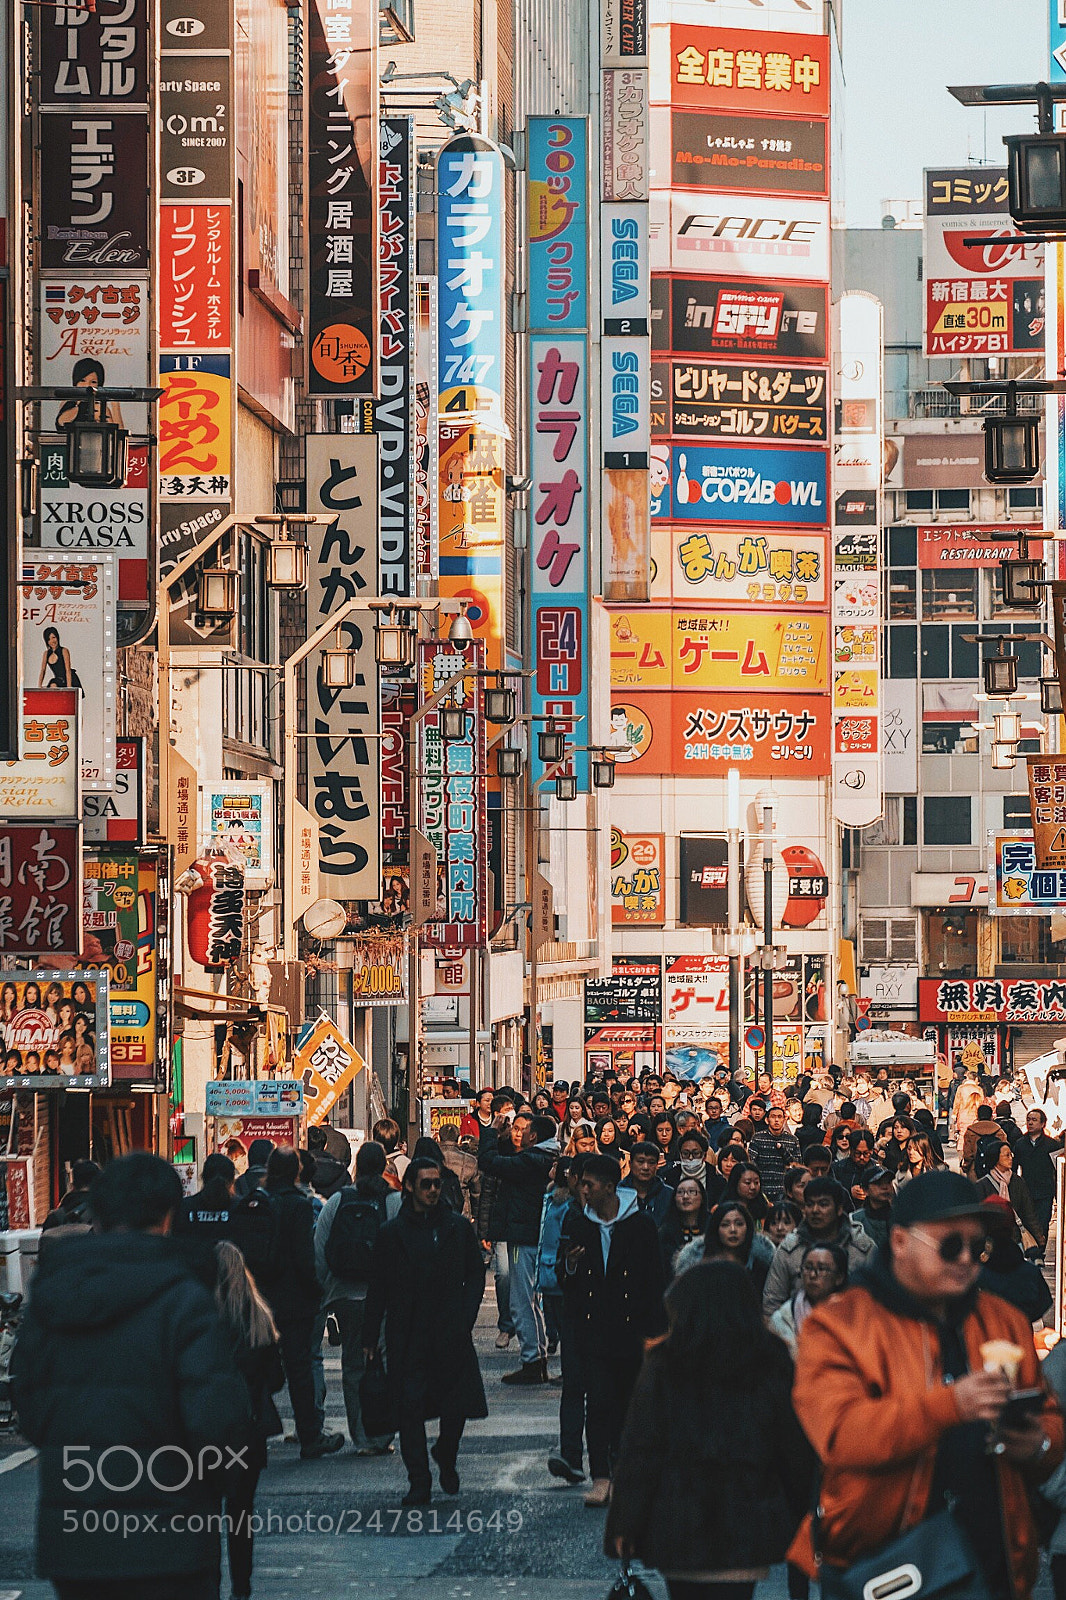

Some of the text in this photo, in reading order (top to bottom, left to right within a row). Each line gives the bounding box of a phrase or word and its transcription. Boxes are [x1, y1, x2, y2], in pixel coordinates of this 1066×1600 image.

[175, 20, 195, 33] 4F
[622, 24, 635, 54] CAFE
[676, 46, 820, 93] 全店営業中
[185, 80, 221, 92] Space
[621, 73, 643, 84] 3F
[181, 137, 226, 147] SINCE 2007
[615, 86, 644, 199] カラオケの鉄人
[706, 136, 755, 149] しゃぶしゃぶ
[675, 152, 823, 173] Mo-Mo-Paradise
[70, 120, 114, 225] エデン
[176, 171, 196, 183] 3F
[932, 177, 1010, 204] コミック
[677, 215, 822, 243] FACE
[942, 218, 1009, 228] comics & internet
[63, 231, 140, 265] Eden
[445, 153, 494, 348] カラオケ
[612, 218, 639, 305] SEGA
[171, 208, 197, 345] リフレッシュ
[206, 208, 221, 339] レンタルルーム ホステル
[67, 284, 141, 304] タイ古式
[932, 280, 1008, 301] 新宿最大
[46, 306, 141, 325] マッサージ
[943, 307, 1005, 329] 直進30m
[80, 327, 141, 336] アジアンリラックス
[620, 320, 631, 333] 2
[80, 346, 134, 356] Relax
[932, 334, 1009, 351] ハイジアB1
[172, 355, 202, 370] 1F
[442, 355, 495, 383] 747
[674, 367, 824, 405] ビリヤード&ダーツ
[612, 352, 639, 439] SEGA
[674, 413, 721, 427] シミュレーション
[720, 408, 770, 435] ゴルフ
[772, 414, 823, 435] バグース
[440, 427, 460, 441] 3F
[47, 452, 64, 471] 肉
[535, 347, 582, 587] カラオケ
[622, 453, 631, 466] 1
[467, 430, 498, 525] 麻雀
[701, 465, 756, 477] 新宿コパボウル
[701, 473, 823, 507] COPABOWL
[43, 501, 144, 524] XROSS
[179, 508, 223, 539] Space
[56, 525, 136, 547] CASA
[678, 533, 822, 584] まんが喫茶
[838, 545, 877, 555] ビリヤード
[939, 547, 1014, 560] RESTAURANT
[852, 555, 876, 563] ゴルフ
[36, 565, 98, 583] タイ古式
[835, 564, 865, 572] BAGUS
[22, 608, 41, 620] 2F
[787, 622, 810, 631] メダル
[784, 633, 814, 642] クレーン
[679, 636, 771, 677] ゲーム
[780, 655, 816, 665] カードゲーム
[779, 667, 808, 676] プリクラ
[23, 719, 70, 742] 古式
[683, 707, 817, 743] メンズサウナ
[841, 719, 872, 730] メンズ
[841, 730, 872, 740] サウナ
[684, 744, 754, 761] 24H 年中無休
[2, 797, 58, 808] Relax
[177, 776, 189, 855] 劇場通り一番街
[213, 809, 261, 821] 出会い喫茶
[633, 844, 655, 856] 24
[1004, 845, 1034, 872] 完
[301, 827, 311, 895] 劇場通り一番街
[83, 863, 135, 880] 開催中
[422, 852, 431, 908] 劇場通り一番街
[613, 988, 638, 997] ゴルフ
[875, 983, 903, 996] AXY
[937, 980, 1066, 1012] 無料案内
[587, 997, 618, 1005] BAGUS
[586, 1027, 596, 1036] 7F
[600, 1030, 655, 1038] FACE
[112, 1045, 143, 1060] 3F
